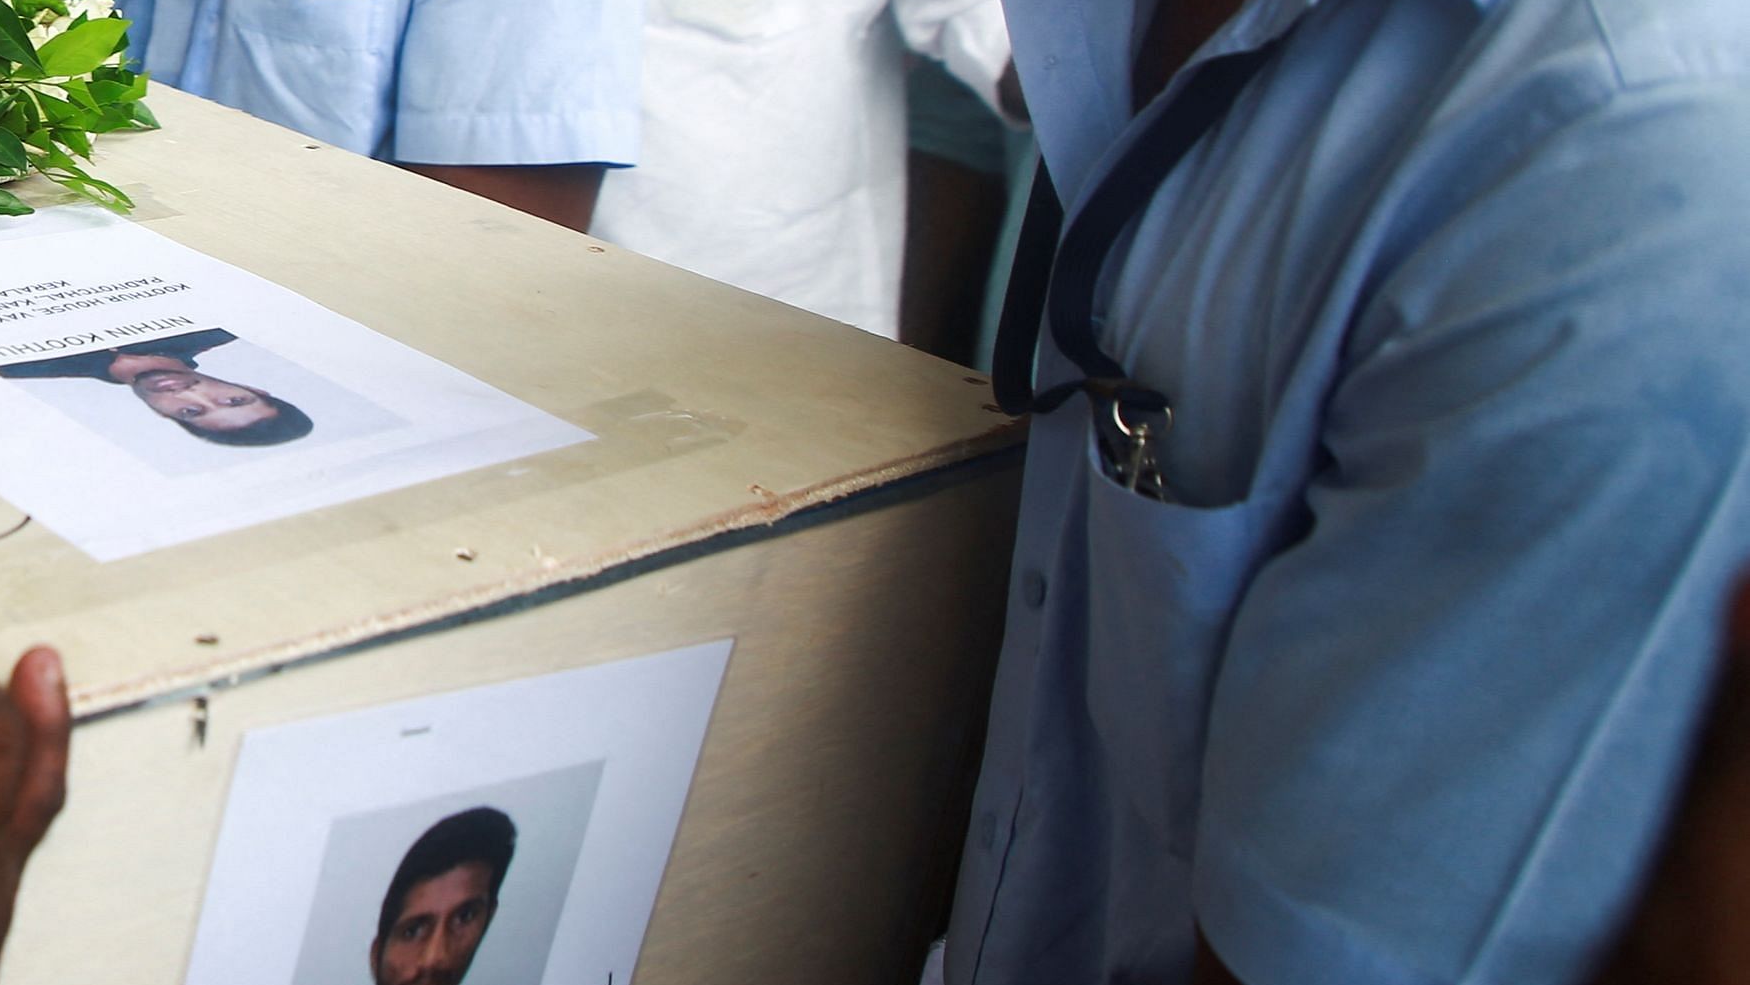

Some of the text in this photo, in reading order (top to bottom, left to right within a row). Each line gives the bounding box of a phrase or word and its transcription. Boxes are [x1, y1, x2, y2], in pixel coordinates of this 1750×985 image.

[35, 276, 164, 300] PADIYOTCHAL,
[109, 283, 191, 303] KOOTHUR
[31, 299, 104, 315] HOUSE,
[106, 316, 194, 339] NITHIN
